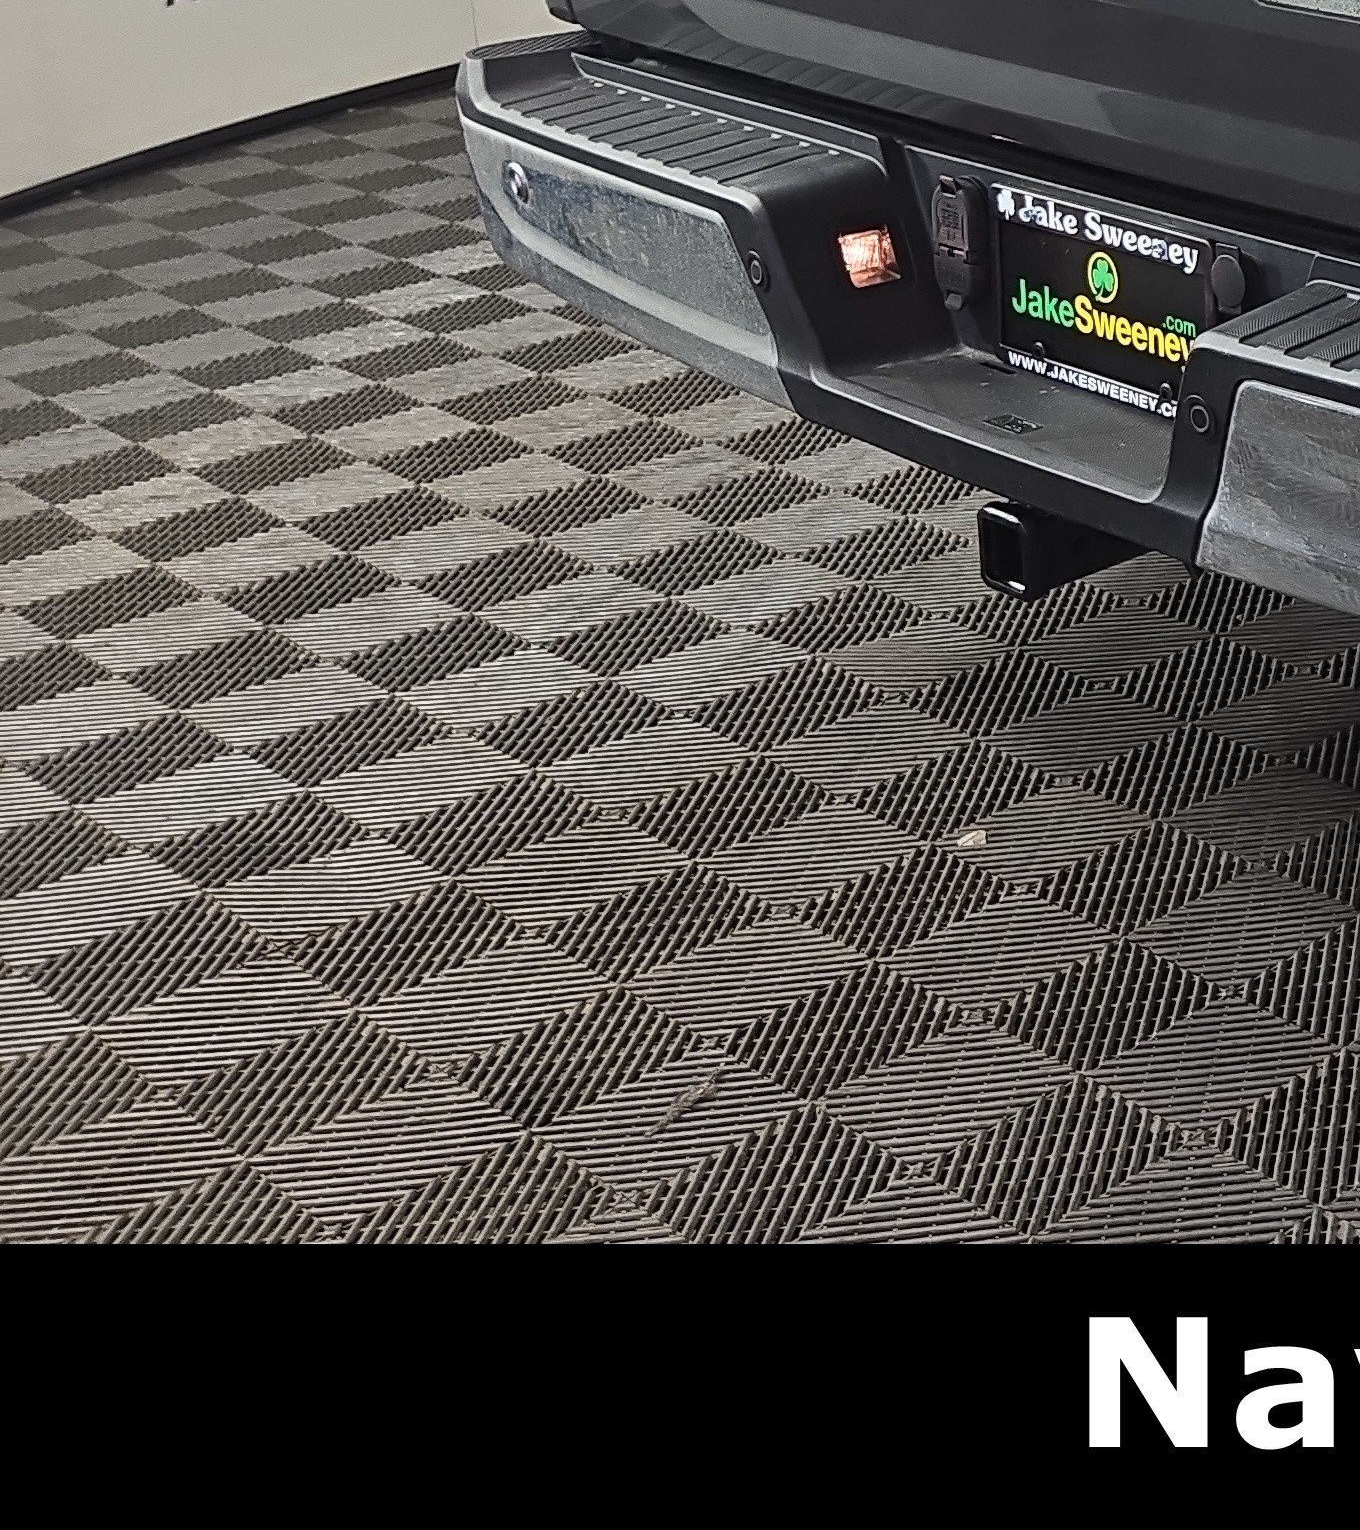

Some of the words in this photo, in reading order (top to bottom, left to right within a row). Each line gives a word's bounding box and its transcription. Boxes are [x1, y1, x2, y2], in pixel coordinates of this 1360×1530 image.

[1018, 194, 1079, 235] Jake
[1083, 210, 1199, 275] Sweeney
[1162, 315, 1196, 338] .com
